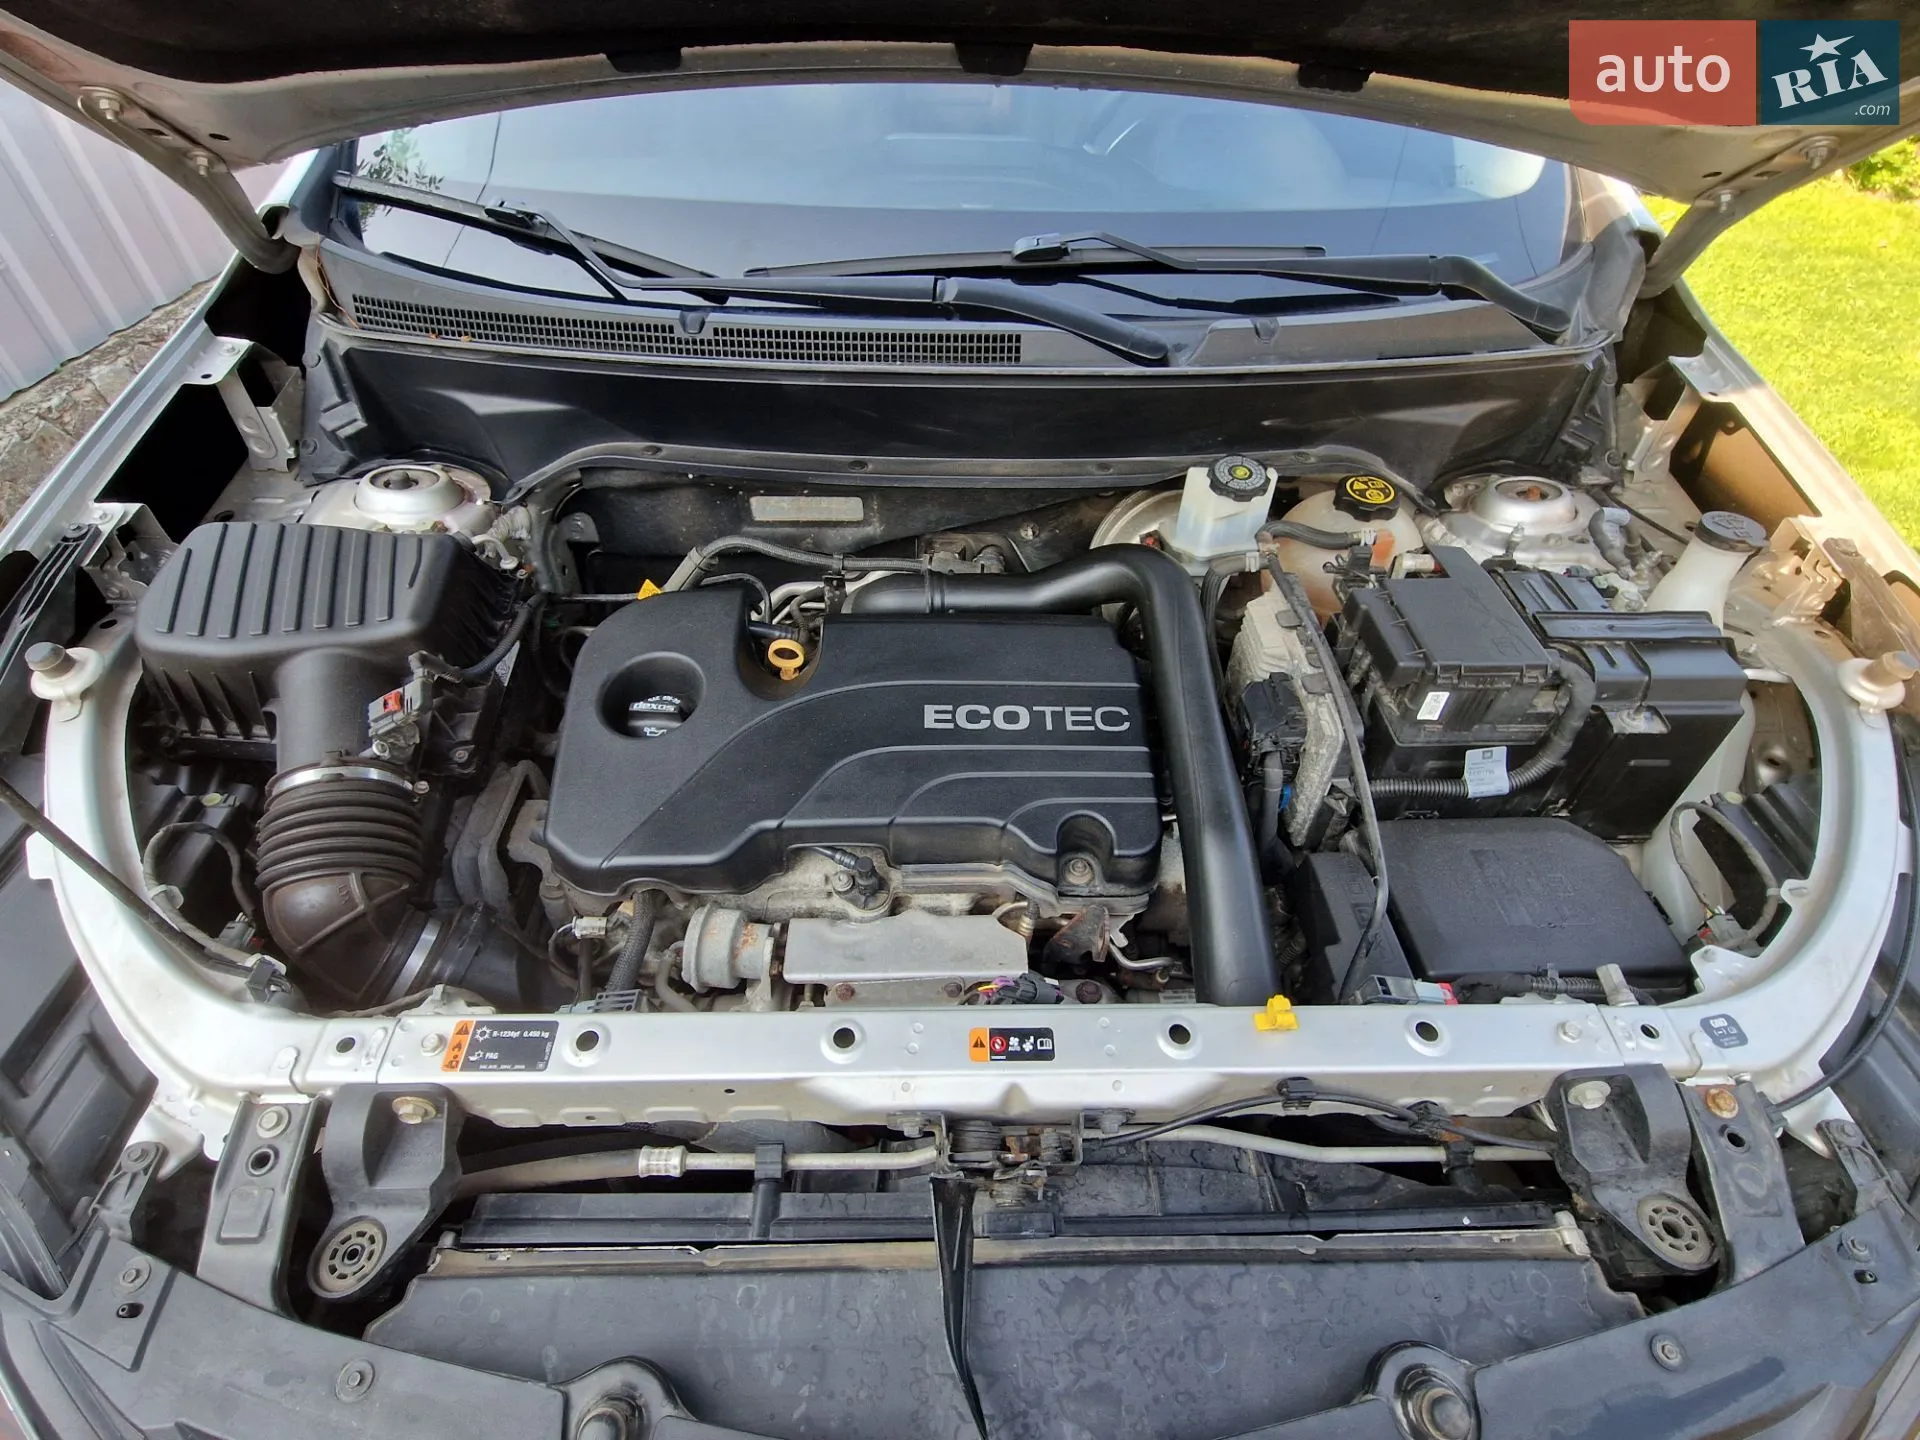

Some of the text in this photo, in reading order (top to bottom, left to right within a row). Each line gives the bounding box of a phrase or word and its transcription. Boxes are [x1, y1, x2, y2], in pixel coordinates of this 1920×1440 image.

[633, 701, 676, 712] dexos
[923, 704, 1131, 732] ECOTEC
[541, 1030, 550, 1039] kg
[485, 1052, 499, 1060] PAG
